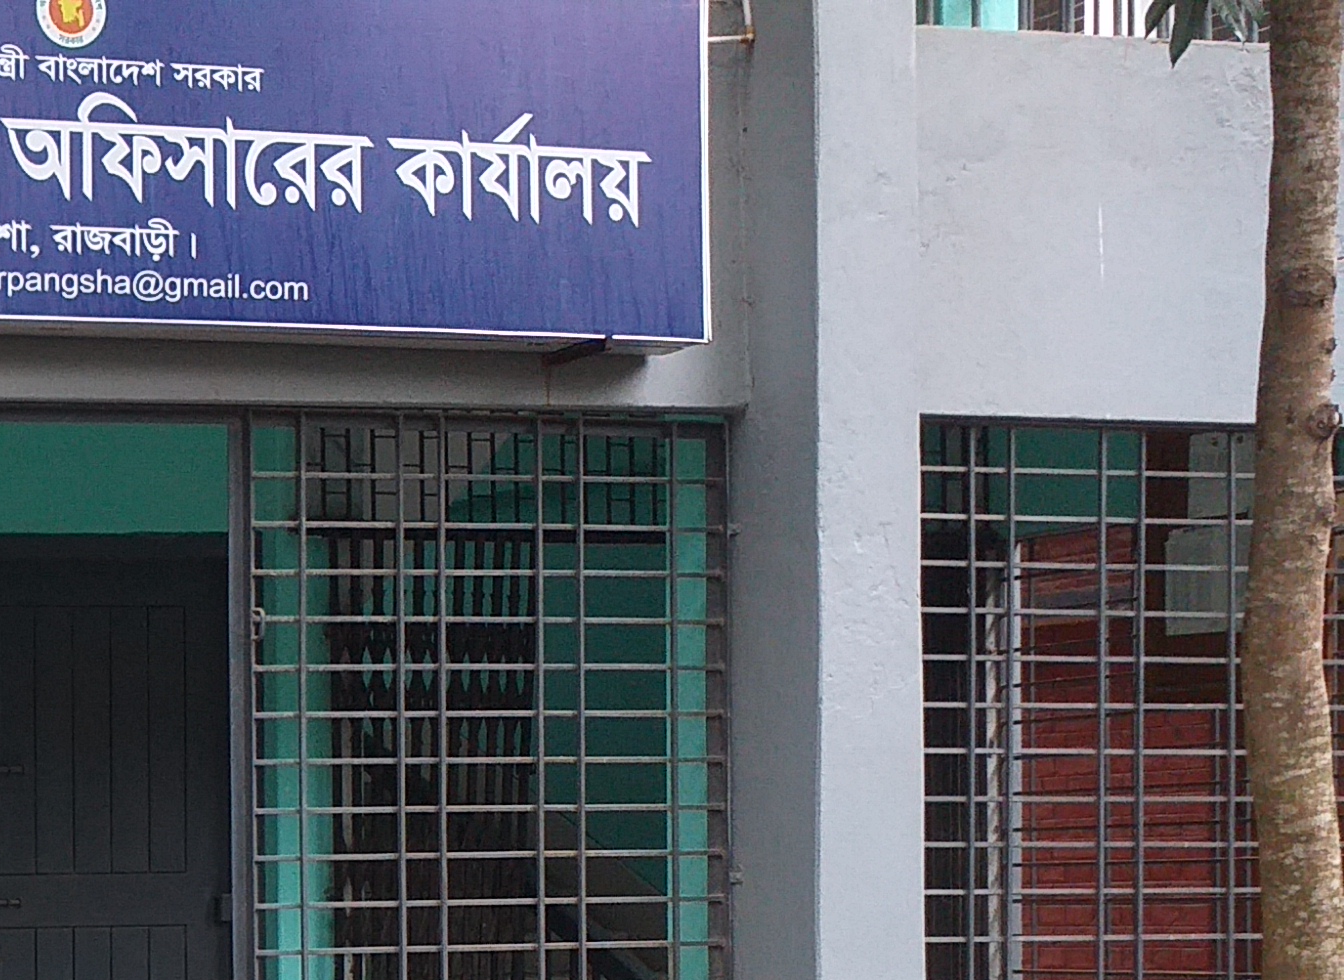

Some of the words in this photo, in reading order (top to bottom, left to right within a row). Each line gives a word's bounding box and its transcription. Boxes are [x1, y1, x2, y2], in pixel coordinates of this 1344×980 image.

[35, 54, 165, 87] বাংলাদেশ
[171, 62, 265, 92] সরকার
[0, 91, 375, 213] অফিসারের
[386, 112, 653, 228] কার্যালয়
